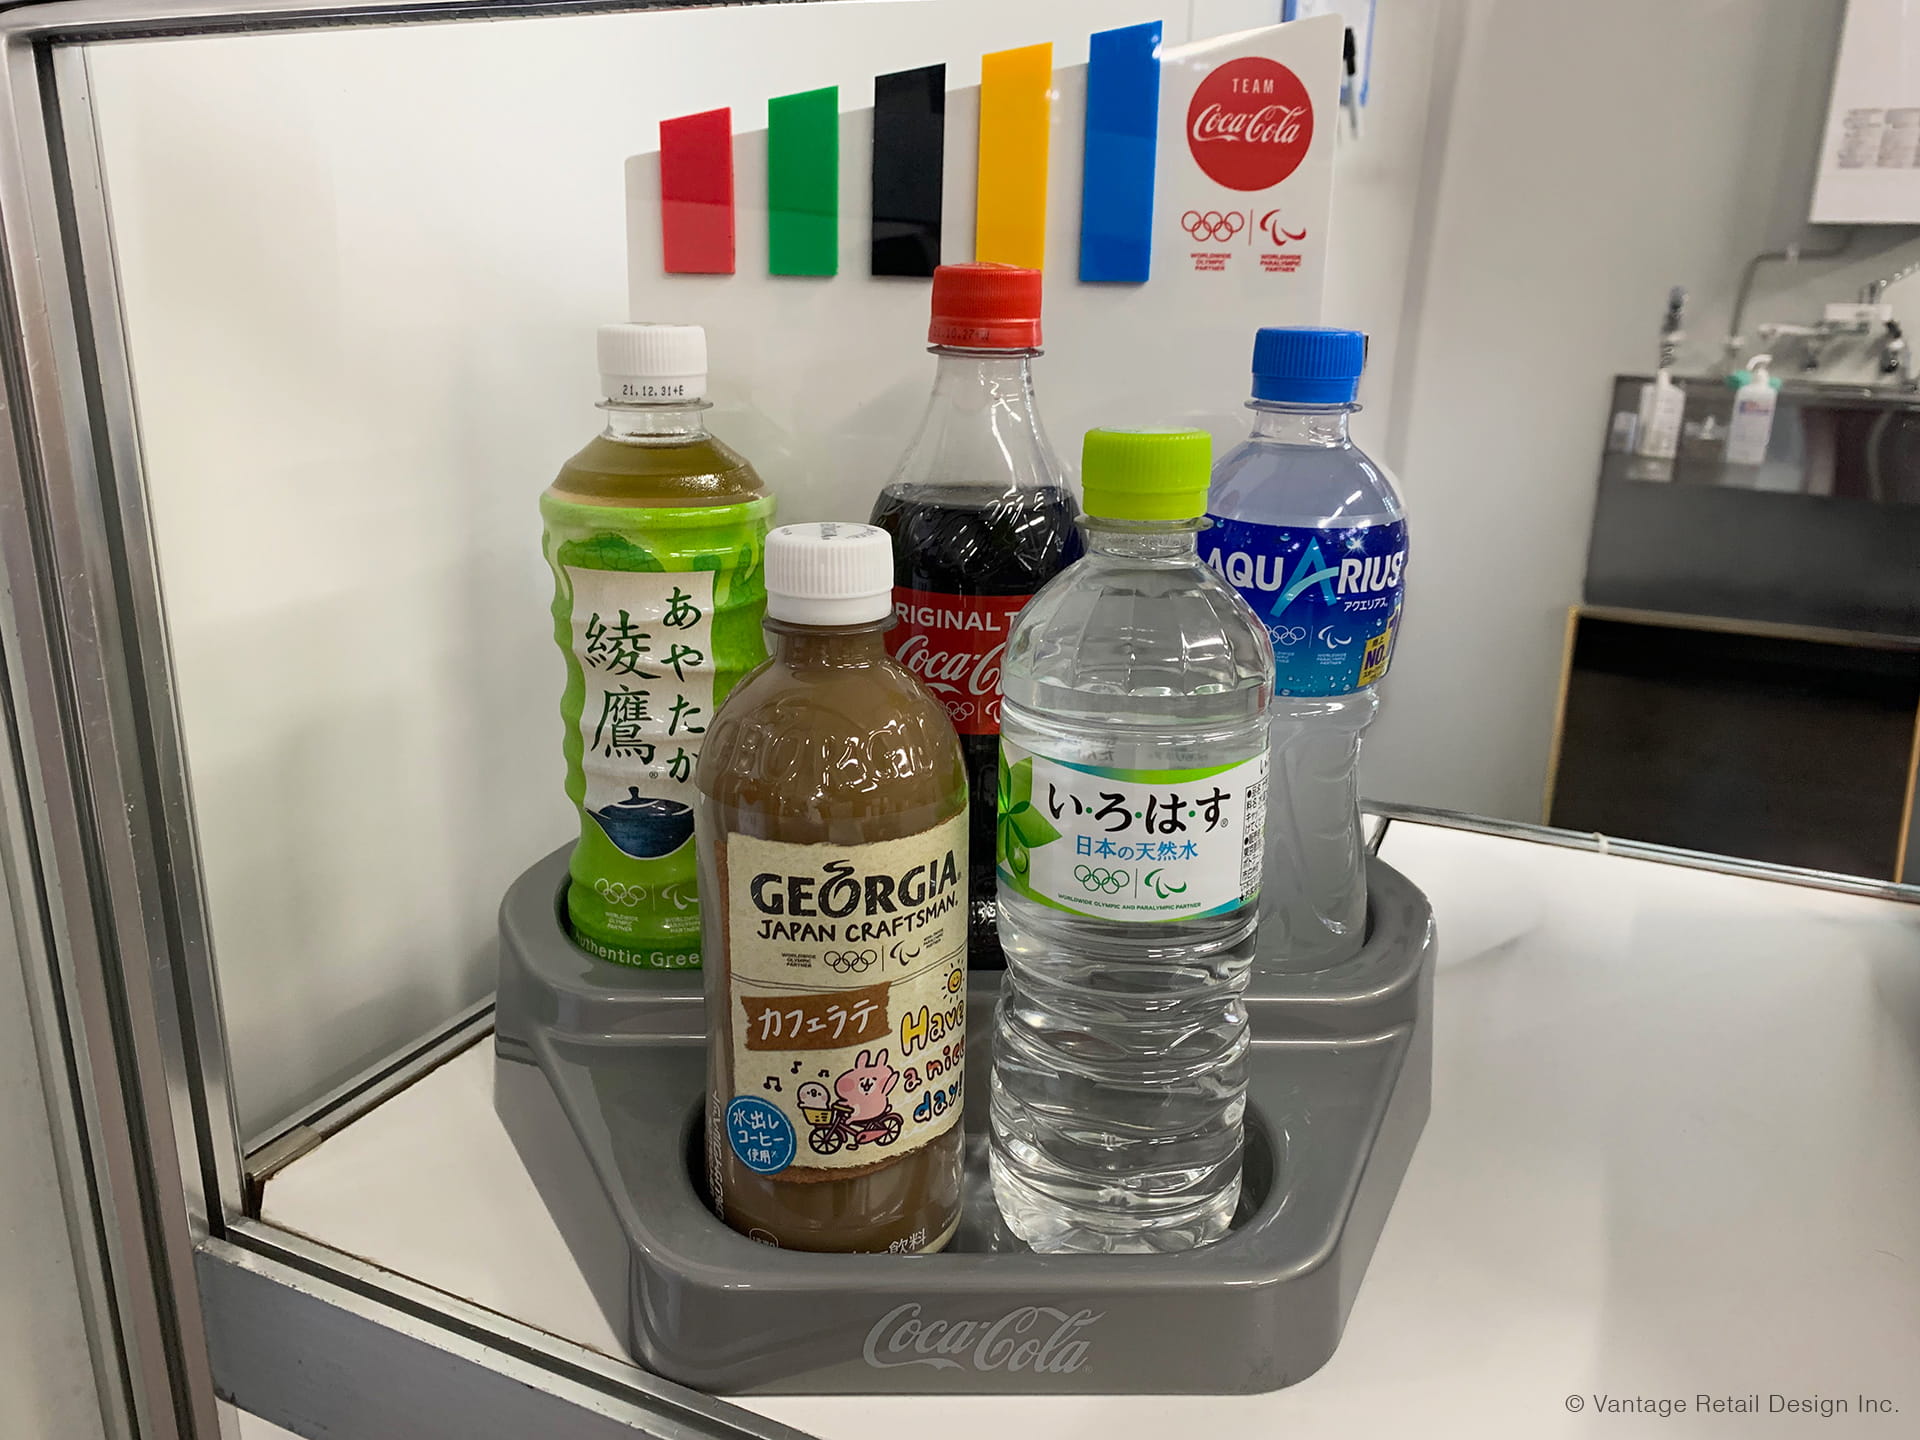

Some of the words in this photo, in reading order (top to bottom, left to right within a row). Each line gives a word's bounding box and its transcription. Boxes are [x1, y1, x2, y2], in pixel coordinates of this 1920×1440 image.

[1232, 78, 1274, 94] TEAM
[1192, 103, 1308, 144] Coca-Cola
[895, 602, 1001, 631] RIGINAL
[1343, 597, 1387, 612] アクエリアス
[895, 635, 1007, 696] Coca-C
[584, 609, 662, 765] 綾鷹
[661, 586, 705, 783] あやたか
[1076, 835, 1199, 861] 日本の天然水
[750, 849, 958, 918] GEORGIA
[1058, 893, 1092, 905] WORLDWIDE
[1094, 901, 1120, 909] OLYMPIC
[757, 920, 836, 942] JAPAN
[575, 930, 642, 966] Authentic
[650, 951, 700, 967] Gree
[758, 999, 878, 1041] カフェラテ
[900, 1000, 965, 1056] Have
[903, 1067, 922, 1093] a
[733, 1108, 780, 1129] 水出し
[738, 1130, 785, 1146] コーヒー
[863, 1302, 1106, 1373] Coca-Cola
